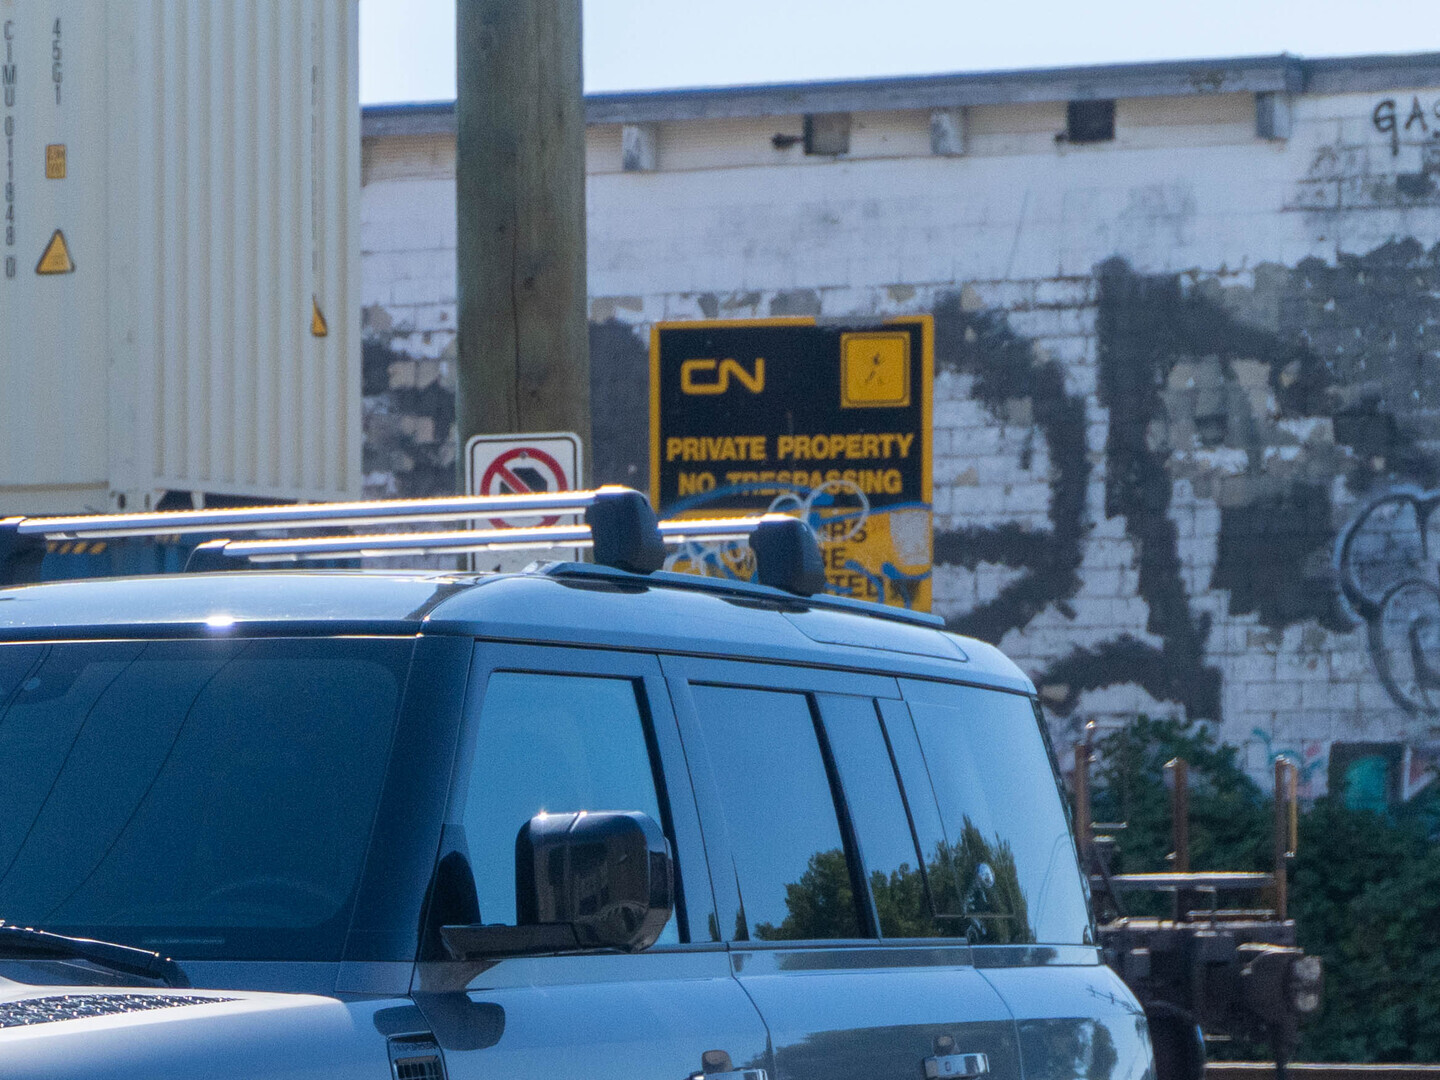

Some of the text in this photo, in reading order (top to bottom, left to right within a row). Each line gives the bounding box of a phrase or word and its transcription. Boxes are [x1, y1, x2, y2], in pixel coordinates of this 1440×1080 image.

[680, 357, 765, 395] CN
[666, 433, 914, 462] PRIVATE PROPERTY
[678, 471, 717, 496] NO
